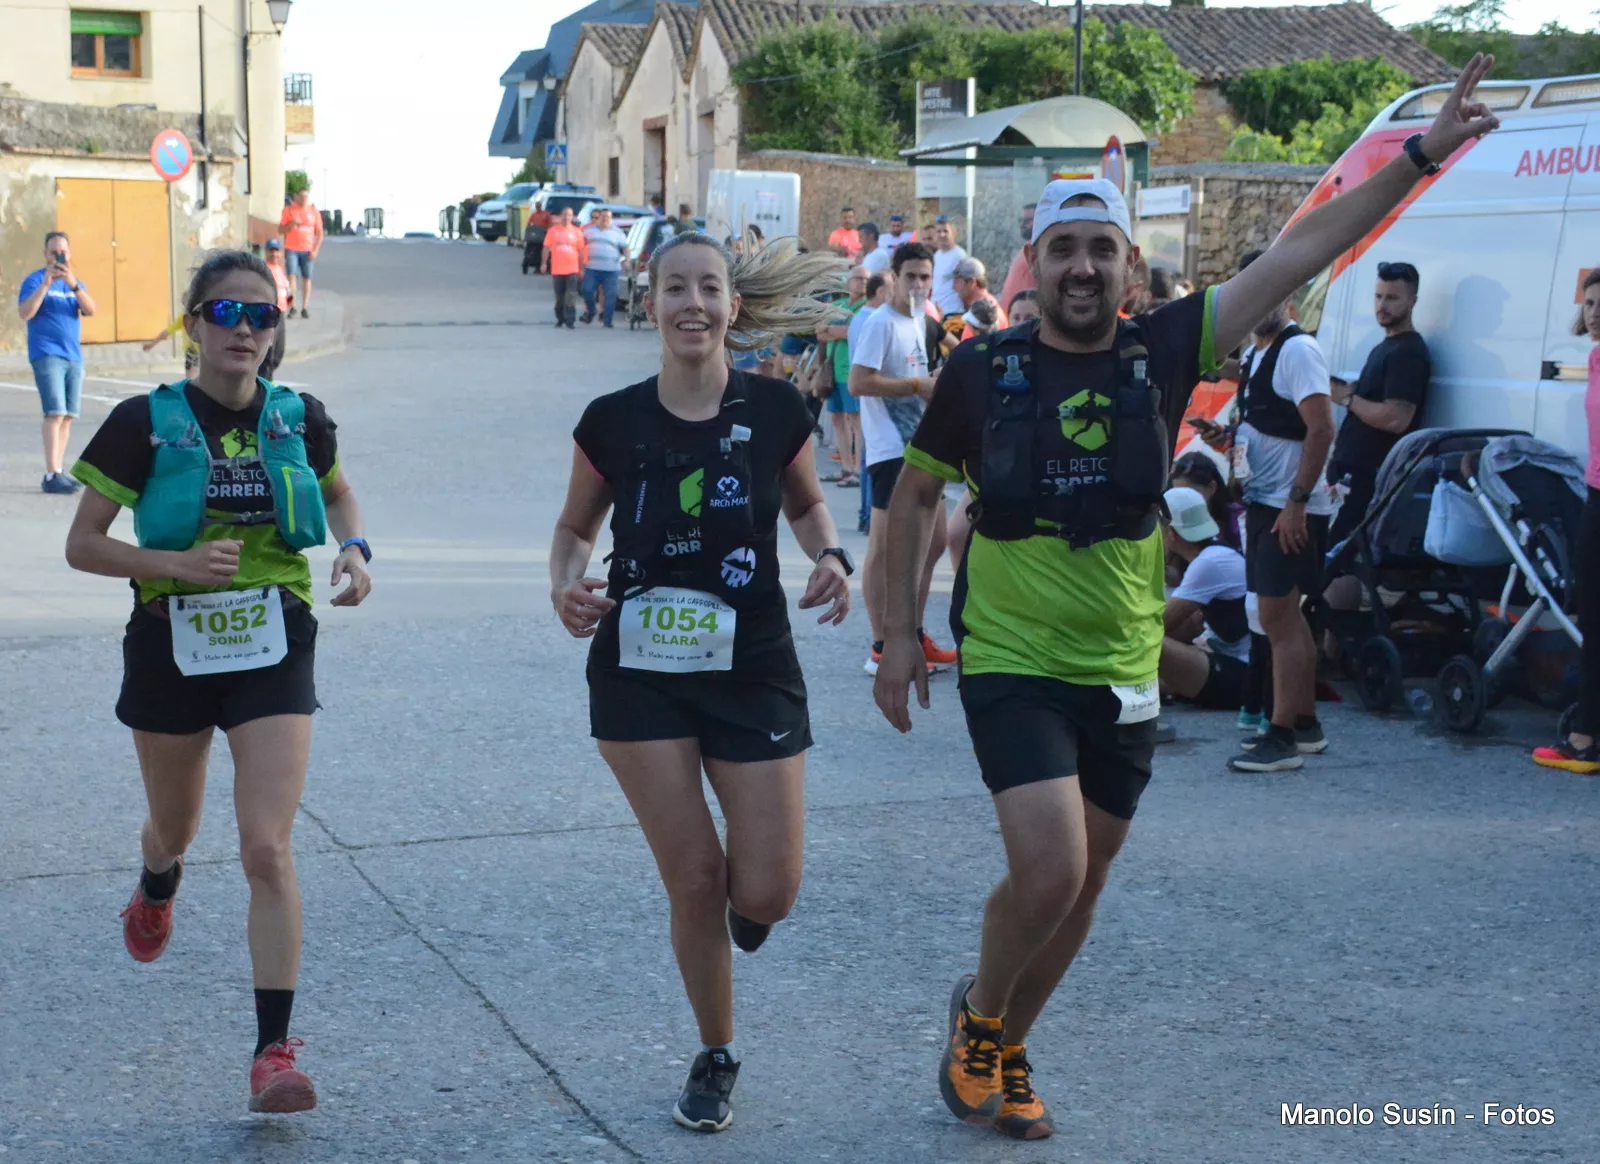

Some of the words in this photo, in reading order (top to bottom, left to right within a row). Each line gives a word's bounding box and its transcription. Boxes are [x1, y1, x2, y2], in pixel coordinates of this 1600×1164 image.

[1047, 459, 1066, 475] EL
[213, 470, 229, 482] EL
[207, 483, 273, 498] ORRER.
[662, 540, 702, 556] ORR
[188, 603, 267, 634] 1052
[638, 605, 719, 634] 1054
[208, 634, 252, 646] SONIA
[652, 633, 699, 646] CLARA
